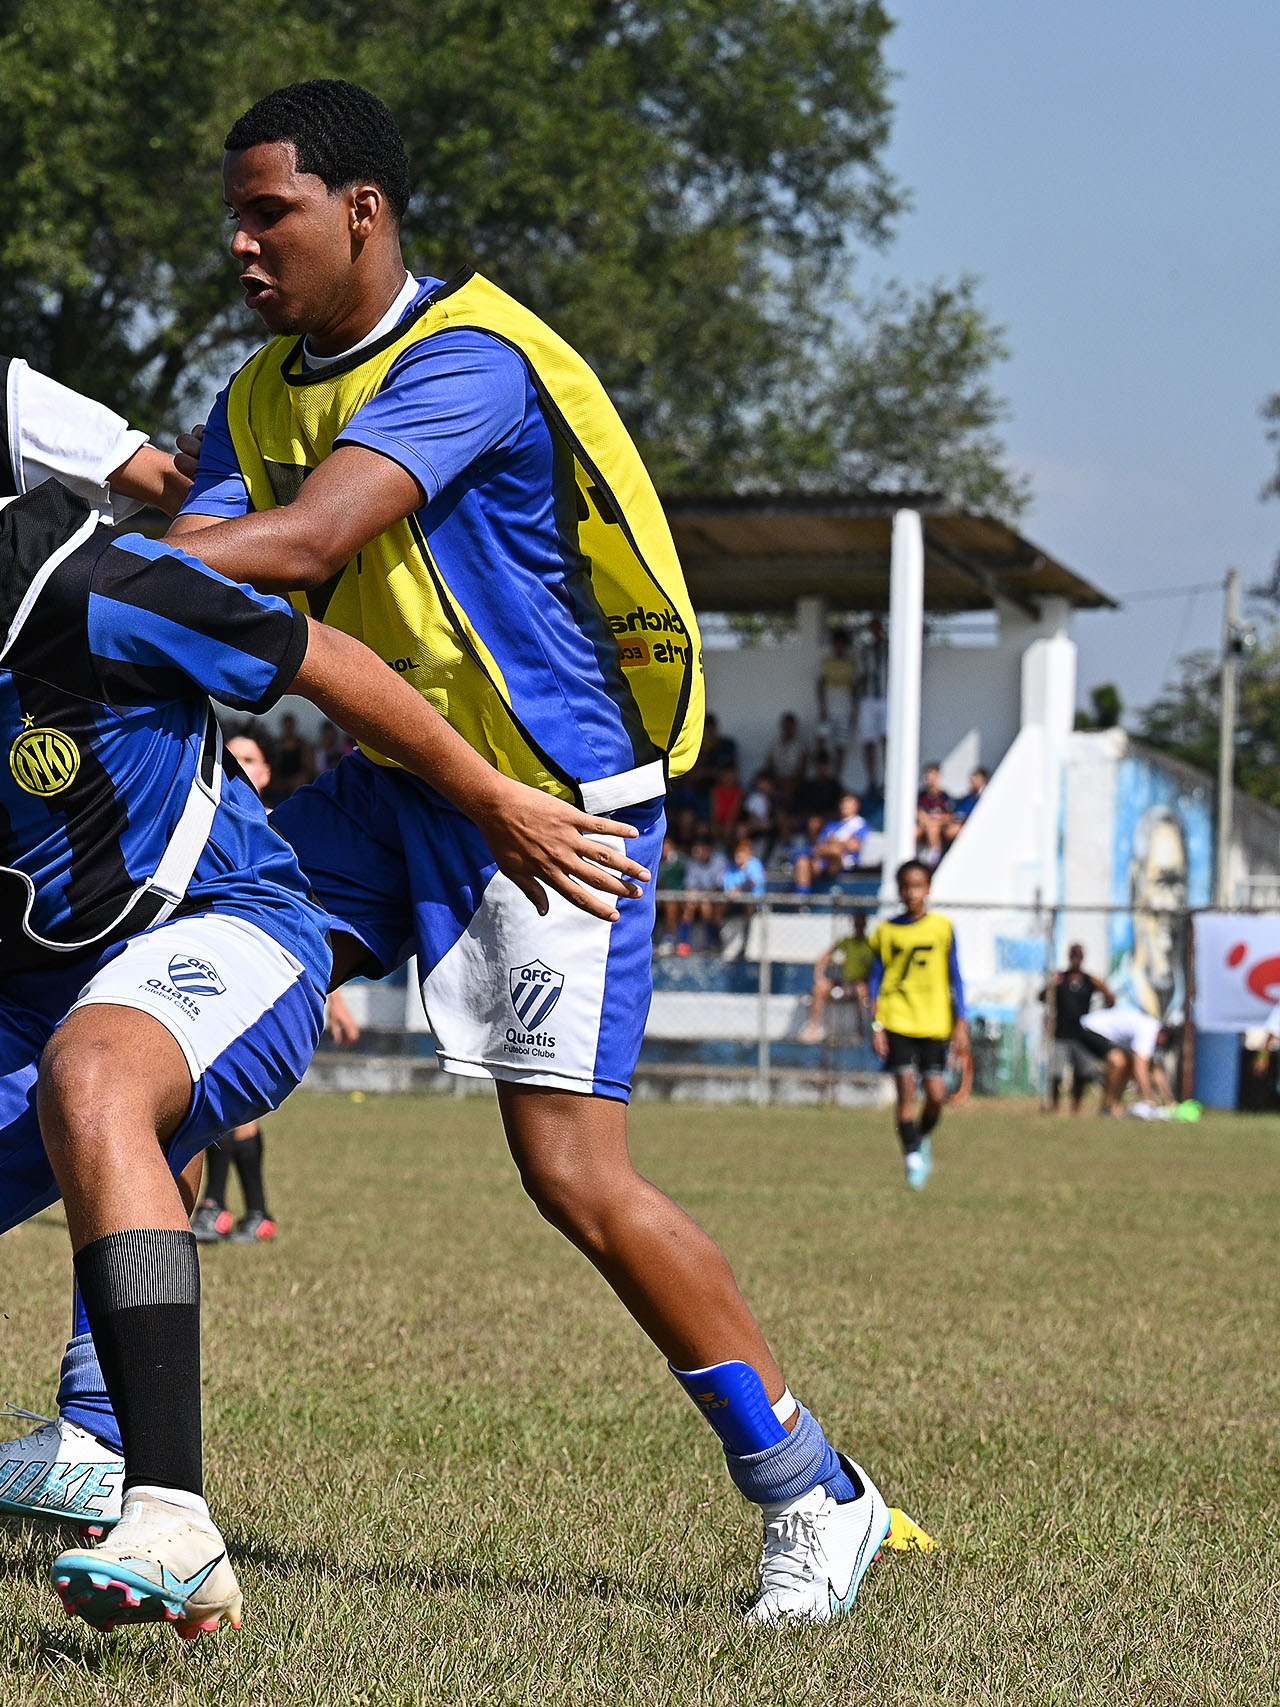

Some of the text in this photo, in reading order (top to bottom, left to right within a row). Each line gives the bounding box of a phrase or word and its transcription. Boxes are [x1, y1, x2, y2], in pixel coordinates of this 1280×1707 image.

[187, 958, 217, 982] QFC
[520, 968, 552, 983] QFC
[146, 979, 201, 1016] Quatis
[505, 1028, 556, 1047] Quatis
[503, 1044, 556, 1059] Futebol Clube
